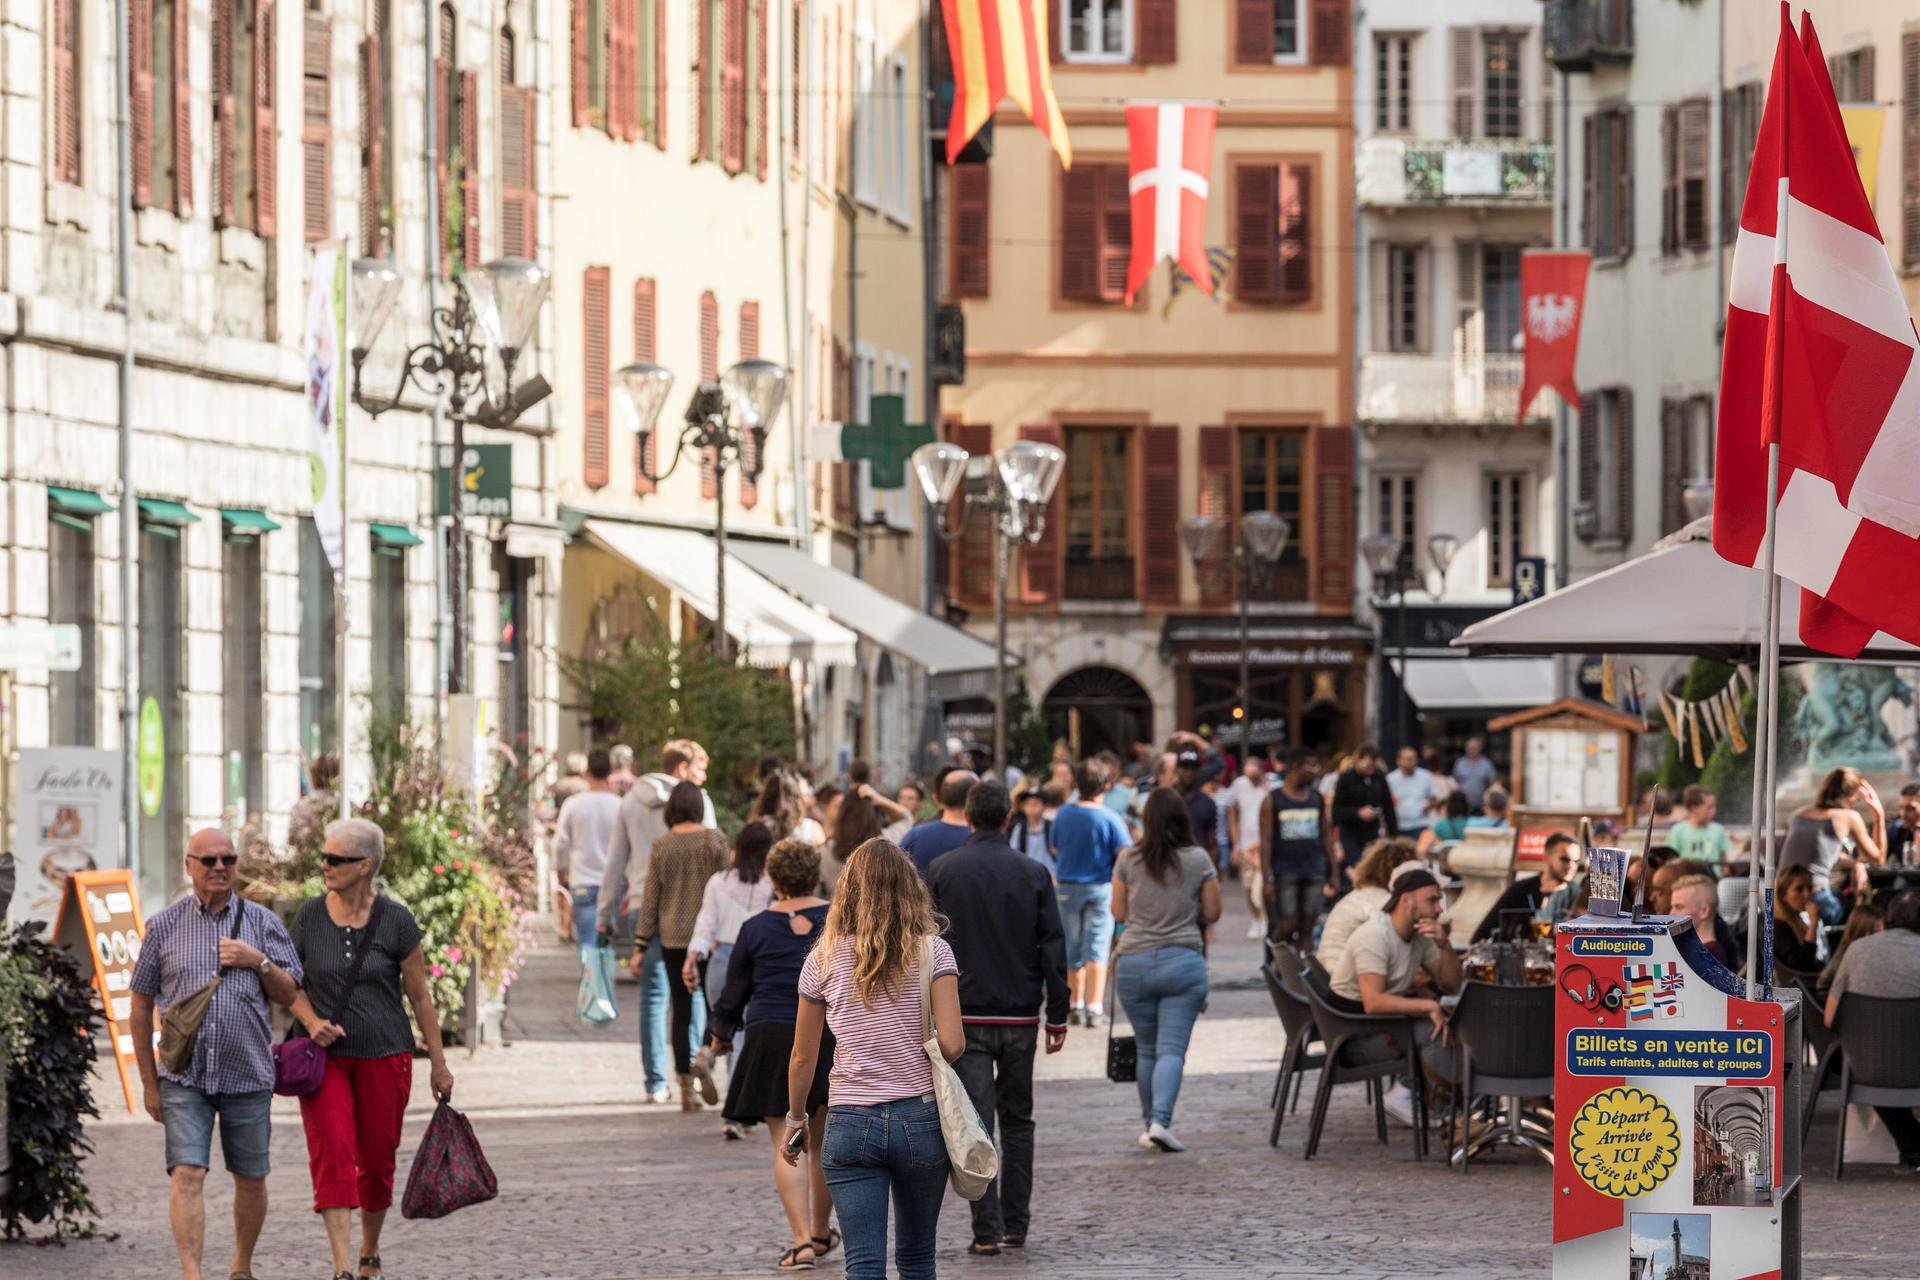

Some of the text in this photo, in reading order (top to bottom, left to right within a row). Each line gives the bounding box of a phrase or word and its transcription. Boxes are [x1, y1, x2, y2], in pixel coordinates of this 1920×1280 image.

[1580, 939, 1646, 953] Audioguide
[1575, 1035, 1763, 1054] Billets en vente ICI
[1576, 1056, 1762, 1071] Tarifs enfants, adultes et groupes
[1596, 1110, 1651, 1129] Départ
[1596, 1128, 1653, 1145] Arrivée
[1590, 1145, 1664, 1181] Visite de 40mn
[1612, 1147, 1641, 1163] ICI
